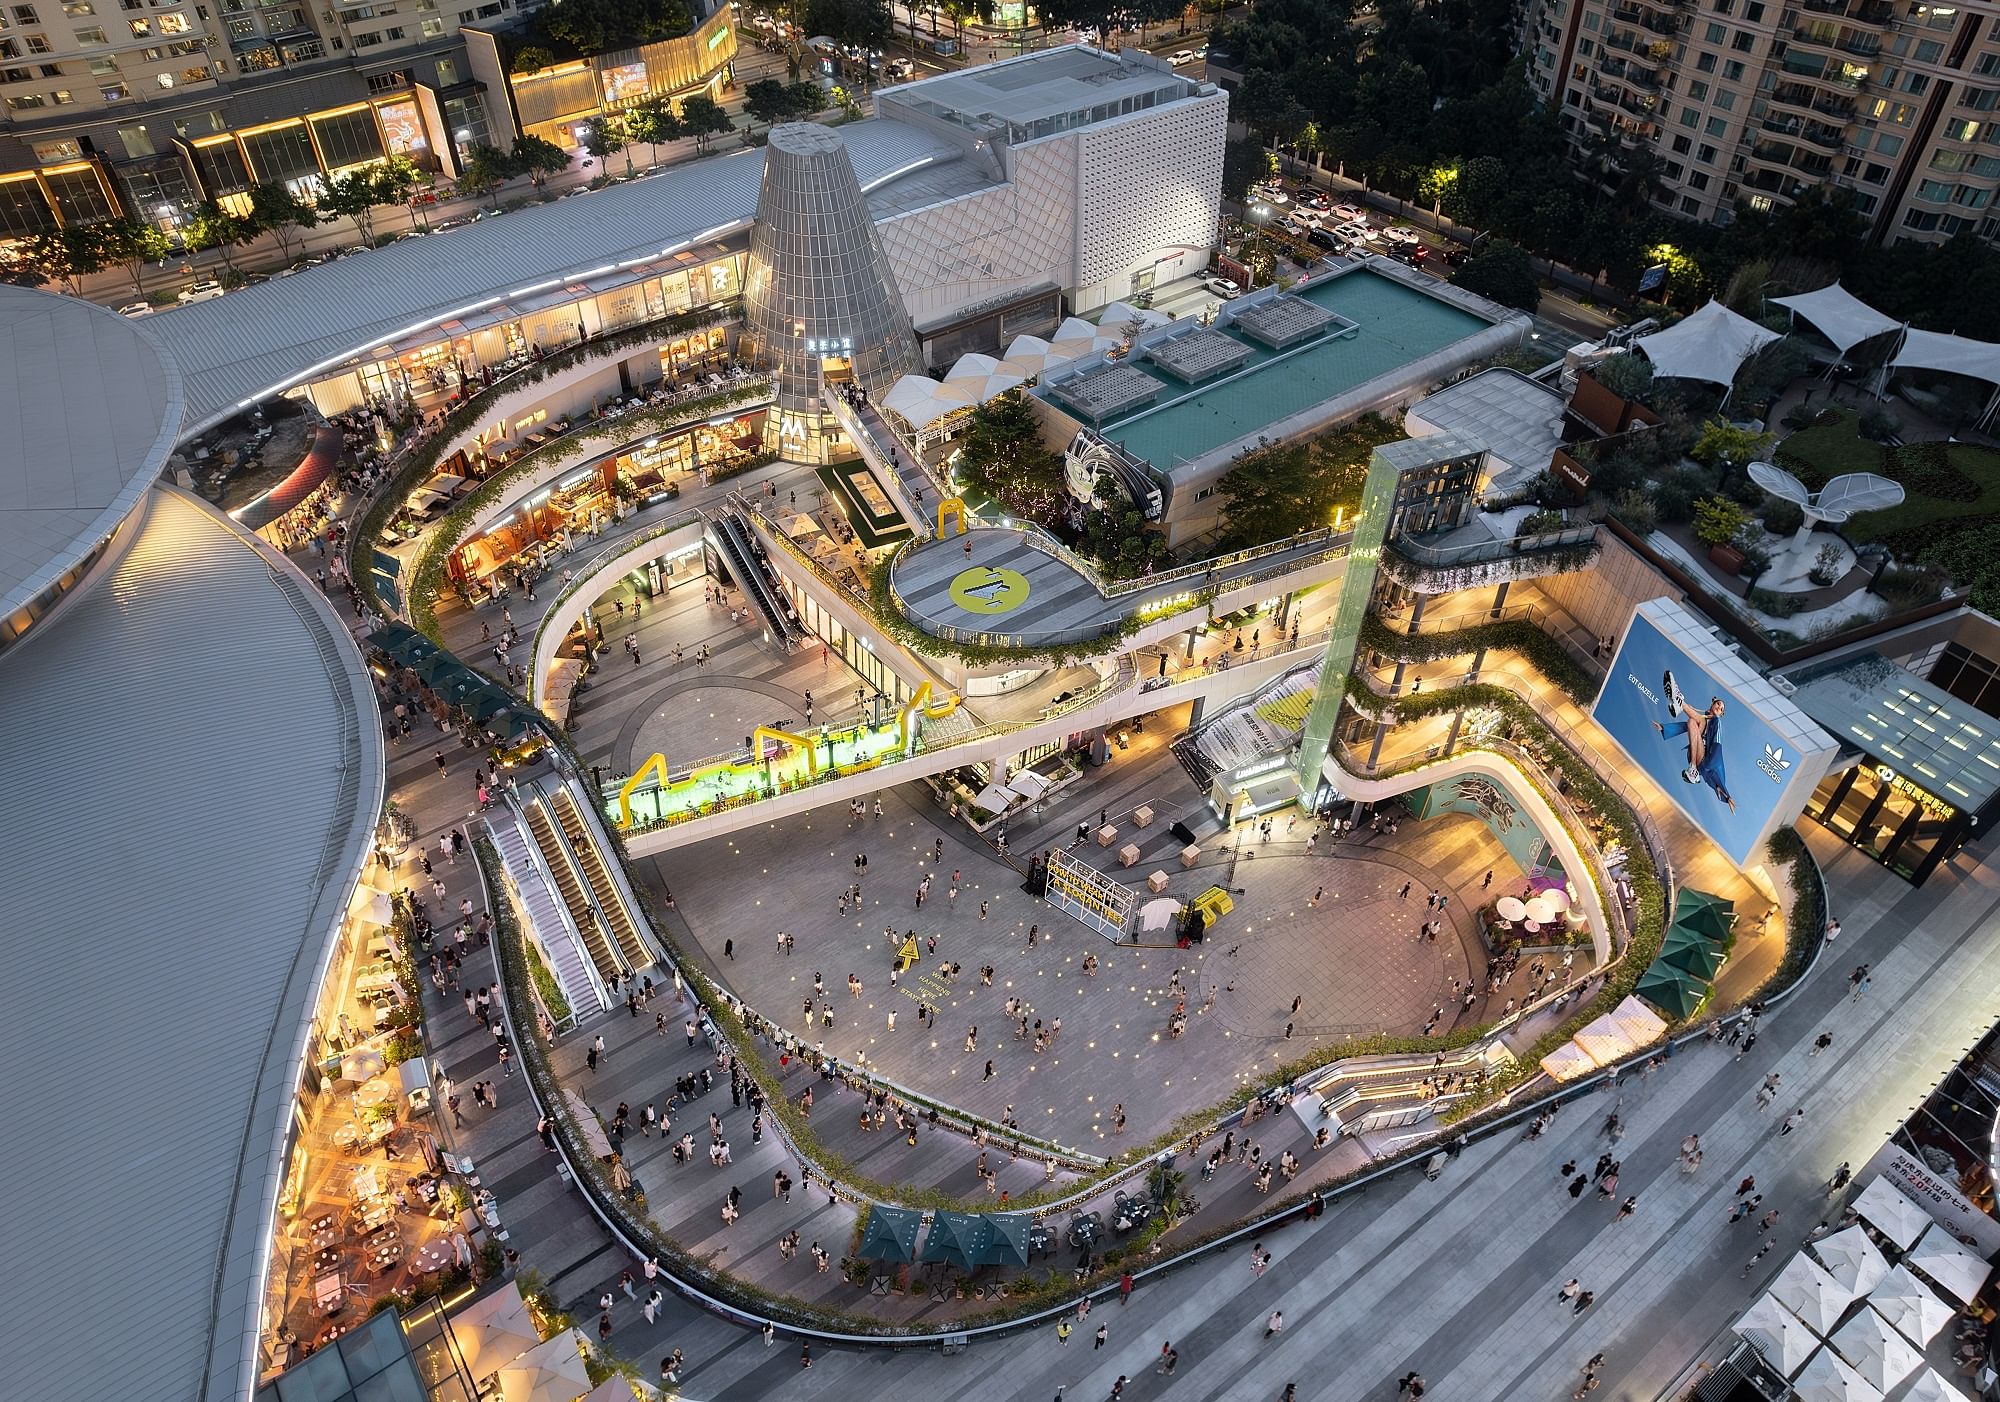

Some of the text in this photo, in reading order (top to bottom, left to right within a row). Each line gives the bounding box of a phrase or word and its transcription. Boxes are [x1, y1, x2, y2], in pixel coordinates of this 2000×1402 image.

[1628, 673, 1660, 705] EQT GAZELLE
[1756, 759, 1782, 784] adidas
[1053, 878, 1061, 888] A
[1063, 884, 1101, 911] SLOGAN
[1079, 876, 1106, 901] WEAR
[918, 975, 951, 996] HAPPENS
[931, 971, 953, 985] WHAT
[917, 986, 938, 1000] HERE
